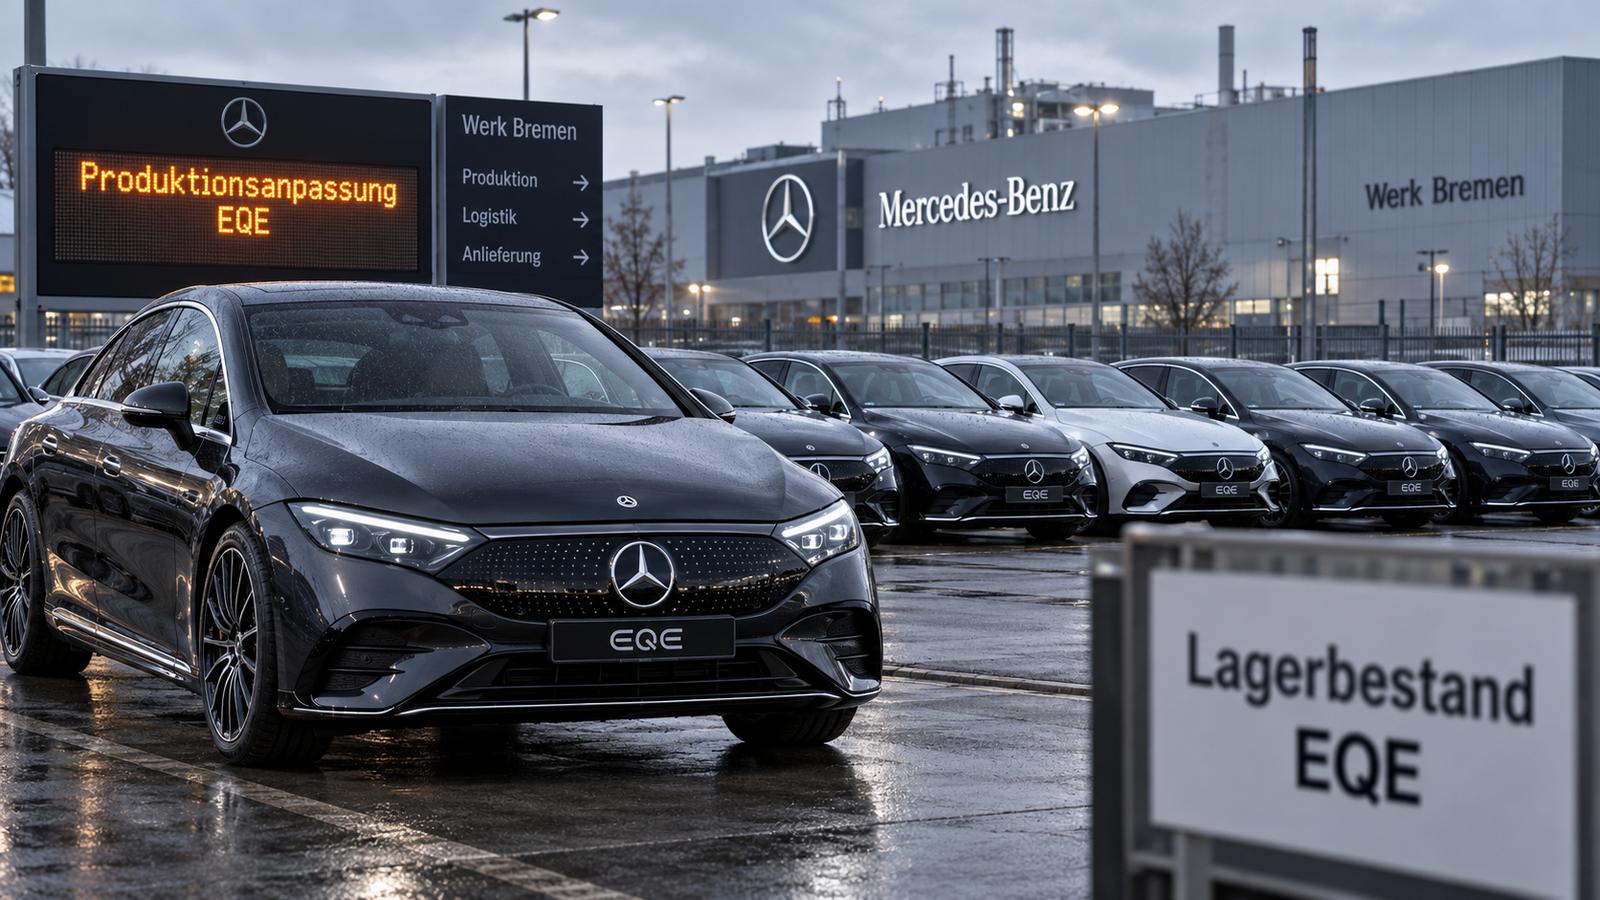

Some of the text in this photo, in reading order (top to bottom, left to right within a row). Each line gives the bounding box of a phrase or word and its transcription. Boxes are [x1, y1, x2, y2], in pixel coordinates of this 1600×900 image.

[462, 113, 578, 141] Werk Bremen
[79, 160, 398, 208] Produktionsanpassung
[462, 168, 538, 188] Produktion
[878, 176, 1076, 229] Mercedes-Benz
[1364, 174, 1526, 211] Werk Bremen
[217, 205, 271, 236] EQE
[462, 206, 518, 228] Logistik
[462, 245, 542, 268] Anlieferung
[1023, 489, 1049, 500] EQE
[1215, 485, 1238, 495] EQE
[1401, 483, 1422, 493] EQE
[611, 628, 682, 651] EQE
[1187, 631, 1535, 728] Lagerbestand
[1296, 727, 1422, 806] EQE
